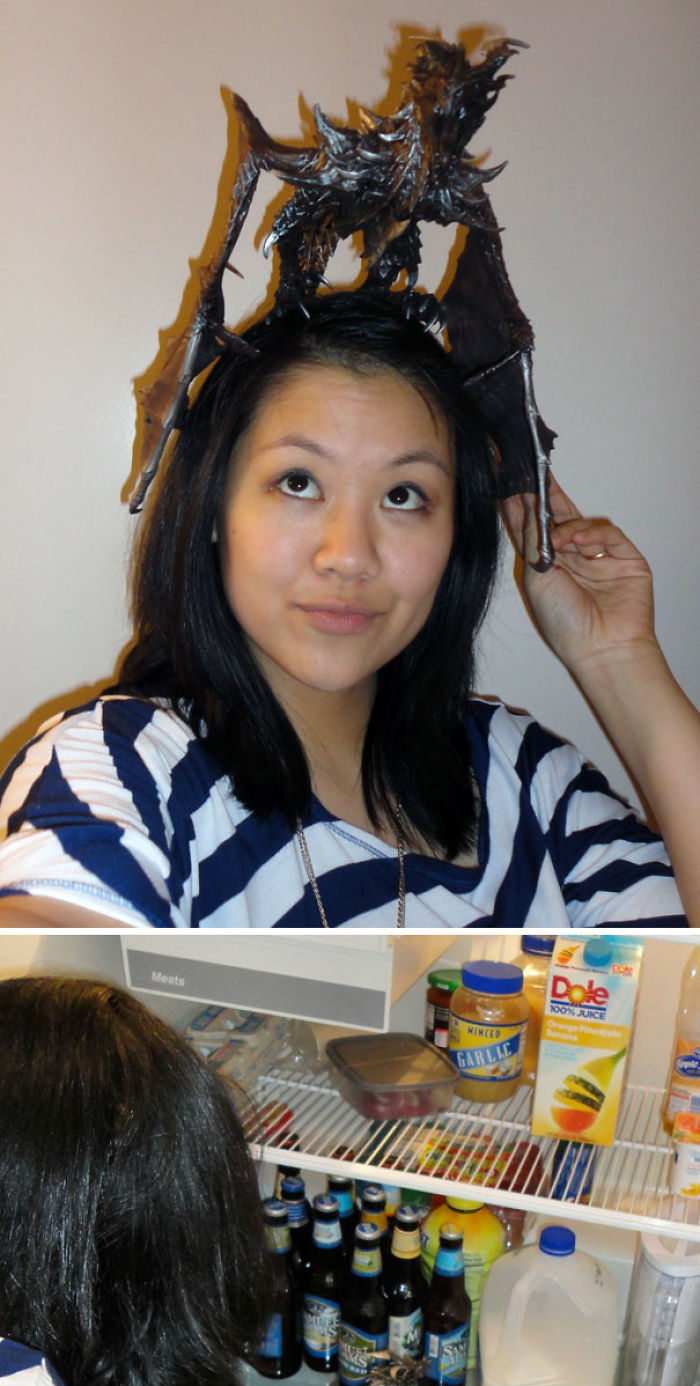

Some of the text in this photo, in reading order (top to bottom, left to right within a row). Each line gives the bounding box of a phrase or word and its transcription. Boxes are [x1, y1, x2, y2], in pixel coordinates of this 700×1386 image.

[151, 971, 185, 987] Meats
[551, 975, 609, 1006] Dole
[550, 1005, 606, 1020] 100% JUICE
[468, 1027, 501, 1039] MINCED
[456, 1041, 512, 1068] GARLIC
